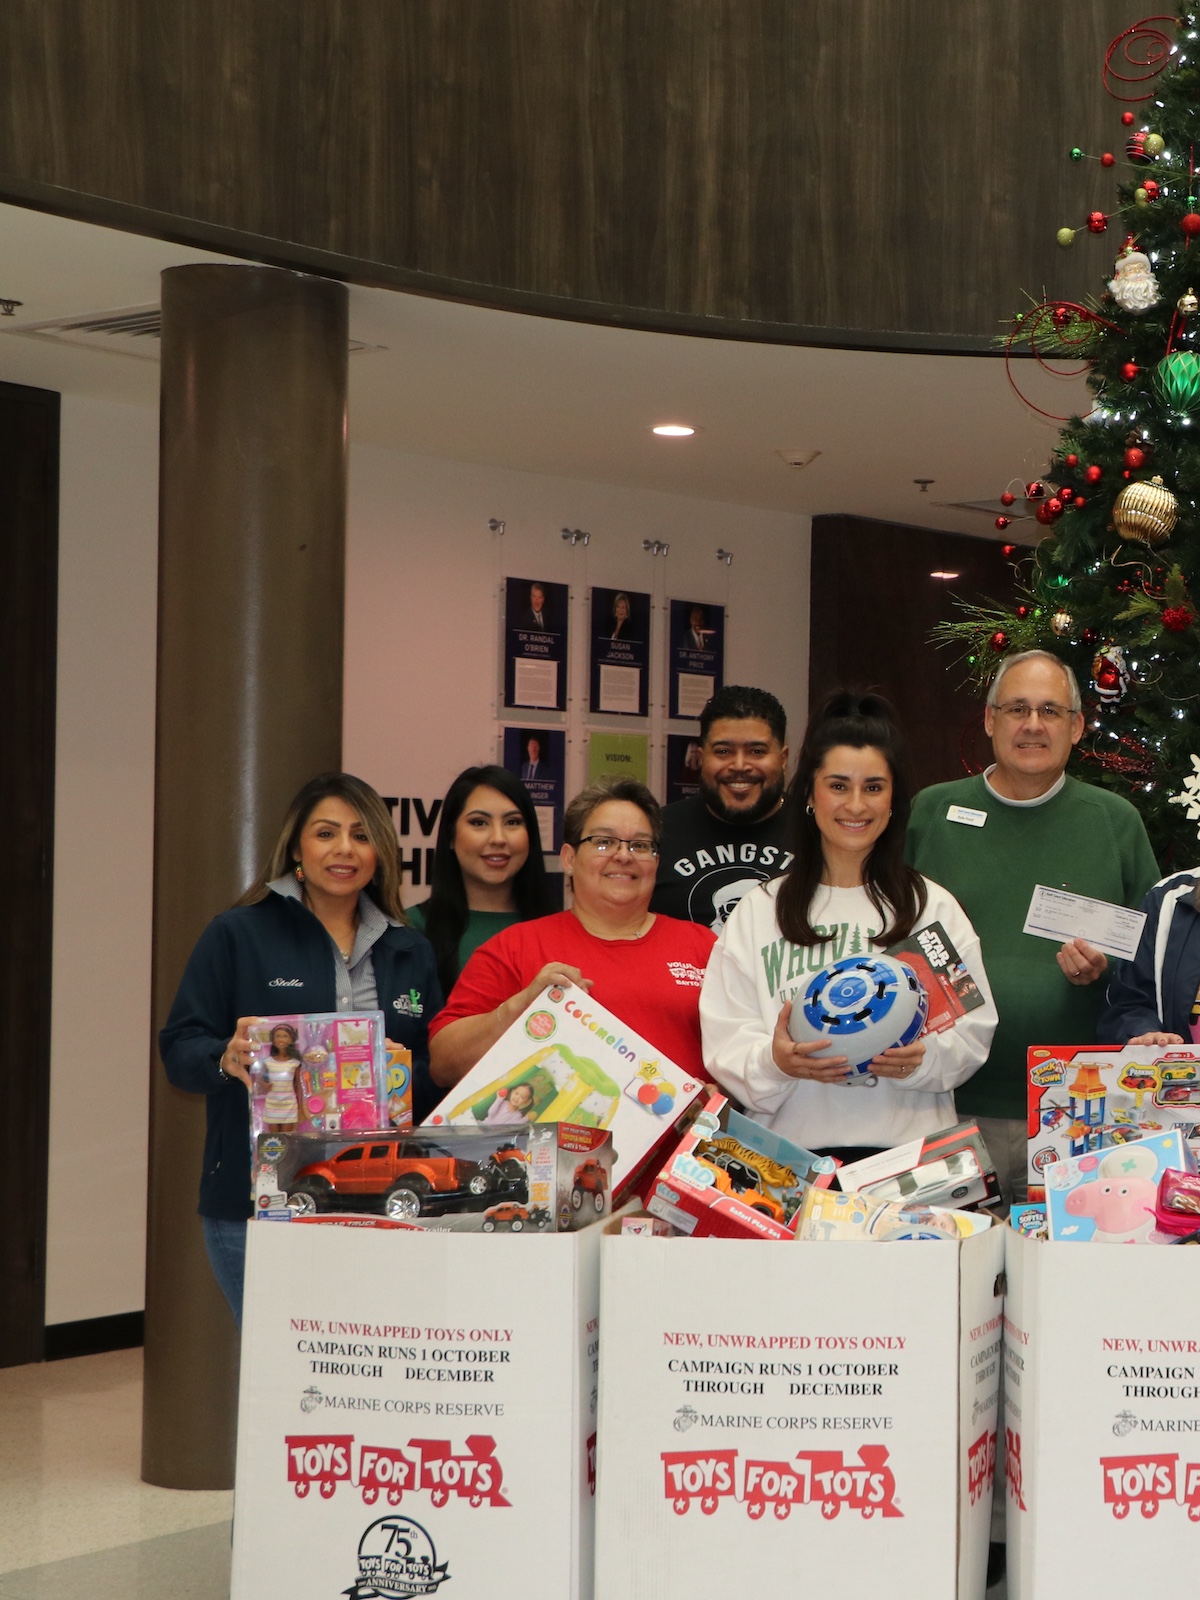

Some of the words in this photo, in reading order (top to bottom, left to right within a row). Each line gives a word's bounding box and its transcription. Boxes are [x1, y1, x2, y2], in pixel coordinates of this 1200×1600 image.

[530, 635, 554, 644] RANDAL
[610, 642, 630, 650] SUSAN
[606, 651, 634, 660] JACKSON
[605, 754, 633, 762] VISION:
[916, 932, 947, 970] WARS
[924, 929, 952, 962] STAR
[268, 978, 304, 988] Stella
[644, 1063, 656, 1076] 20
[1040, 1074, 1062, 1084] TOWN
[1040, 1154, 1051, 1163] 25
[729, 1206, 751, 1223] Safari
[751, 1219, 768, 1232] Play
[768, 1227, 781, 1240] Set
[290, 1319, 324, 1336] NEW,
[328, 1321, 422, 1341] UNWRAPPED
[424, 1328, 466, 1342] TOYS
[470, 1329, 514, 1342] ONLY
[663, 1332, 703, 1349] NEW,
[707, 1334, 810, 1350] UNWRAPPED
[815, 1336, 857, 1350] TOYS
[862, 1337, 906, 1350] ONLY
[1102, 1338, 1142, 1354] NEW,
[297, 1340, 374, 1358] CAMPAIGN
[378, 1346, 416, 1360] RUNS
[420, 1349, 427, 1360] 1
[432, 1349, 510, 1363] OCTOBER
[310, 1361, 383, 1378] THROUGH
[405, 1367, 494, 1383] DECEMBER
[668, 1360, 754, 1376] CAMPAIGN
[759, 1363, 802, 1376] RUNS
[807, 1364, 813, 1376] 1
[818, 1363, 899, 1376] OCTOBER
[1107, 1365, 1195, 1379] CAMPAIGN
[684, 1380, 764, 1396] THROUGH
[789, 1383, 882, 1396] DECEMBER
[324, 1397, 381, 1412] MARINE
[384, 1400, 431, 1414] CORPS
[435, 1403, 504, 1416] RESERVE
[701, 1414, 763, 1429] MARINE
[766, 1416, 817, 1429] CORPS
[822, 1417, 892, 1429] RESERVE
[290, 1443, 348, 1477] TOYS
[362, 1453, 410, 1485] FOR
[424, 1458, 492, 1492] TOTS
[668, 1458, 731, 1492] TOYS
[746, 1466, 798, 1500] FOR
[815, 1471, 884, 1502] TOTS
[1107, 1463, 1172, 1497] TOYS
[360, 1558, 380, 1569] TOYS
[385, 1561, 400, 1572] FOR
[407, 1563, 429, 1576] TOTS
[366, 1578, 427, 1593] ANNIVERSARY
